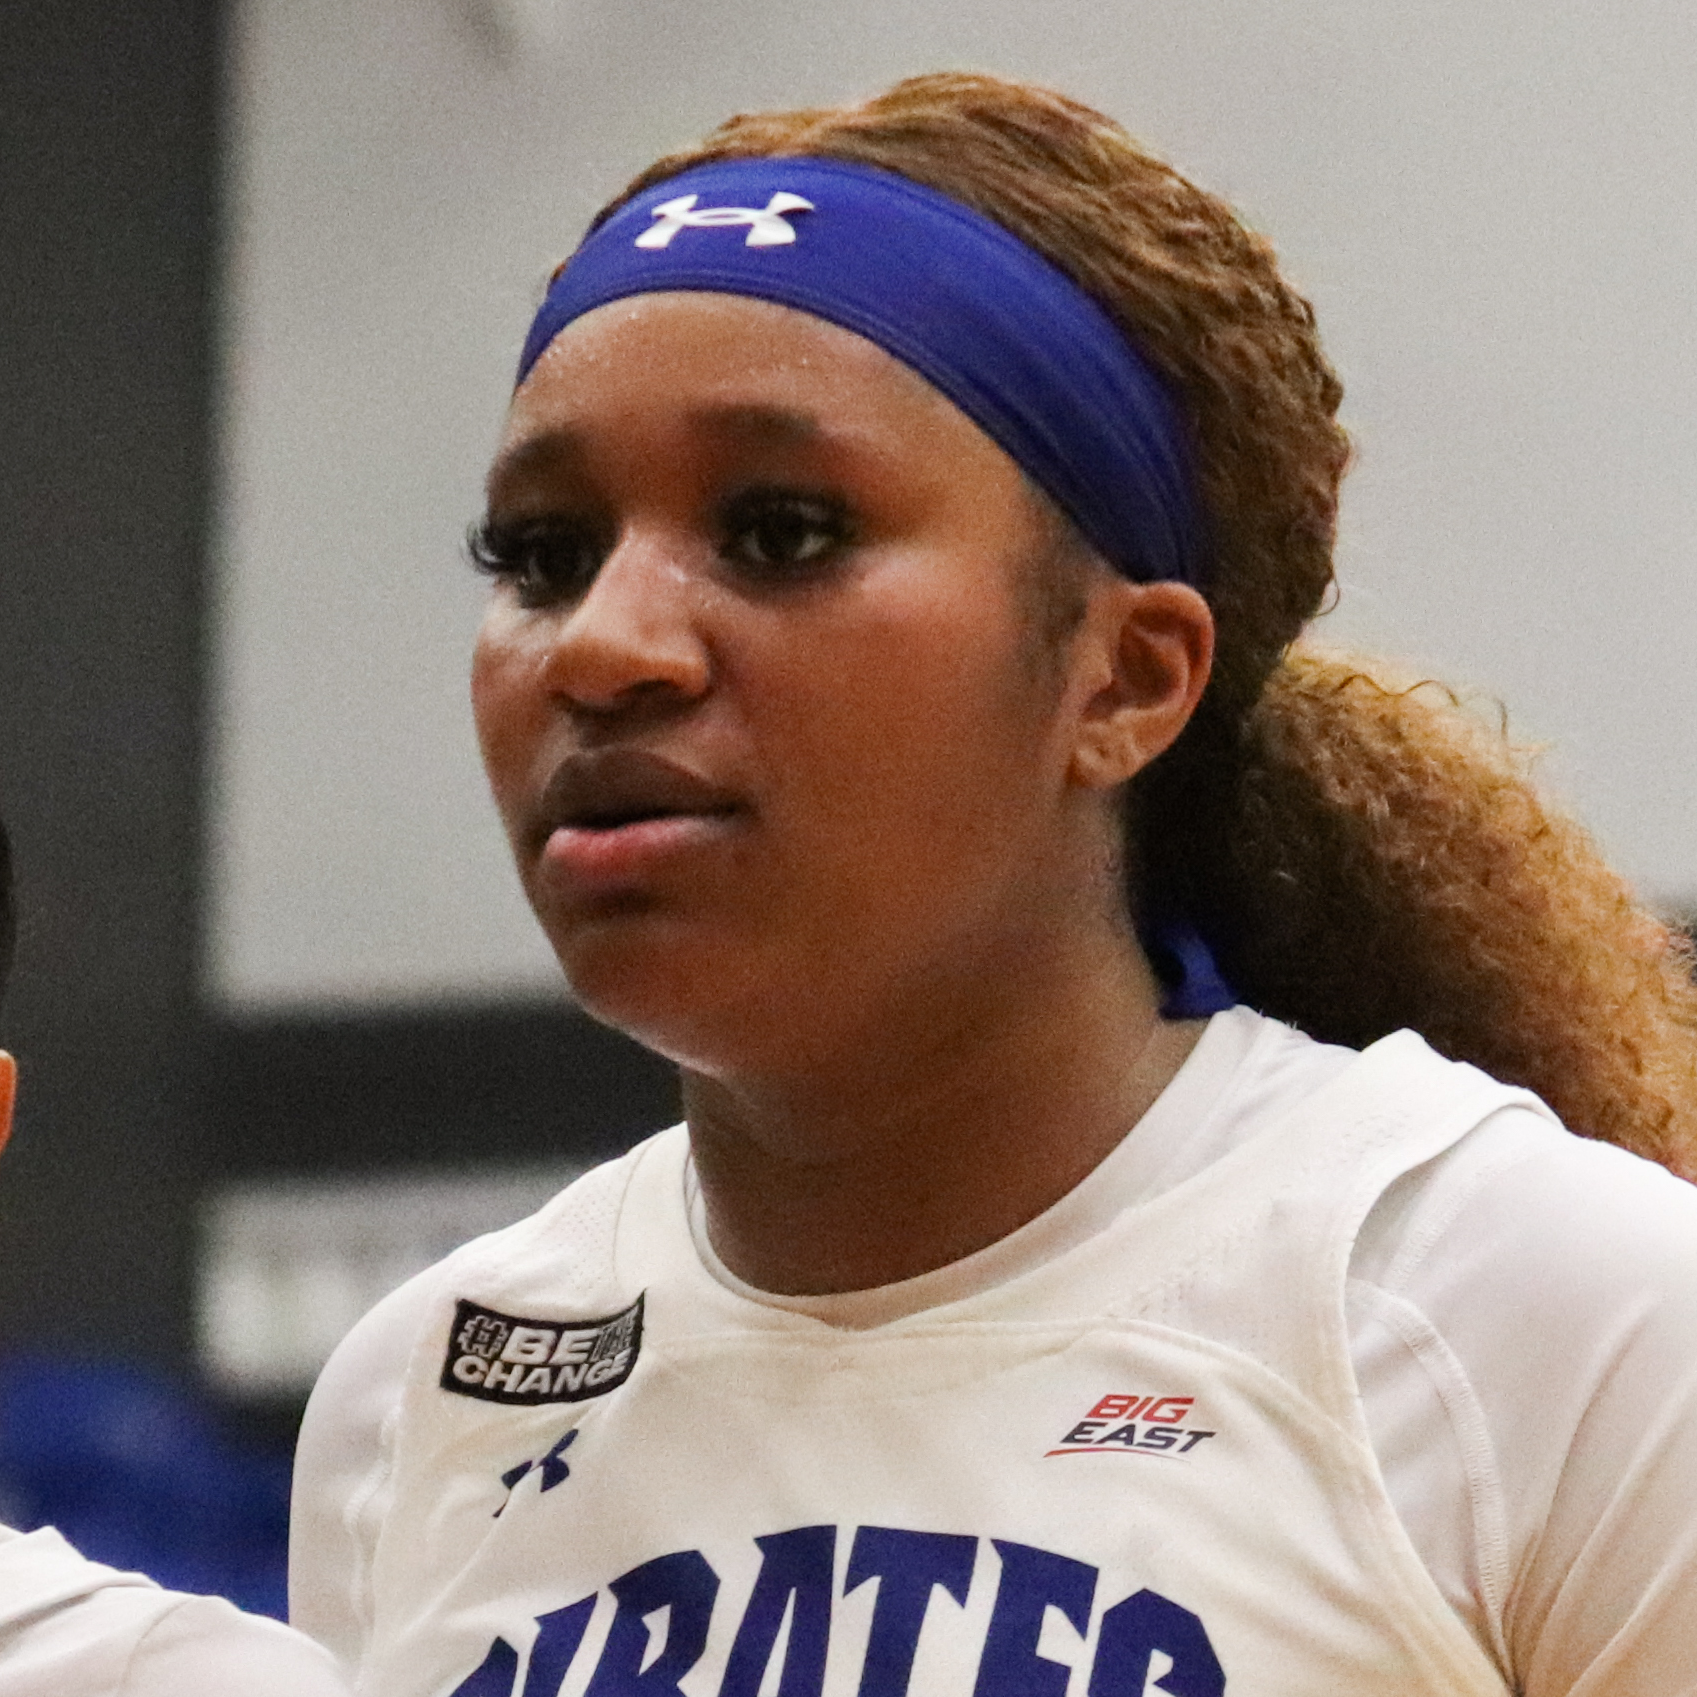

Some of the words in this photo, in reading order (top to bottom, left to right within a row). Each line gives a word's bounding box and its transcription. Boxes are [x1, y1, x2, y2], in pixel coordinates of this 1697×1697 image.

[453, 1350, 632, 1395] CHANGE
[1085, 1394, 1196, 1424] BIG
[1060, 1421, 1216, 1452] EAST
